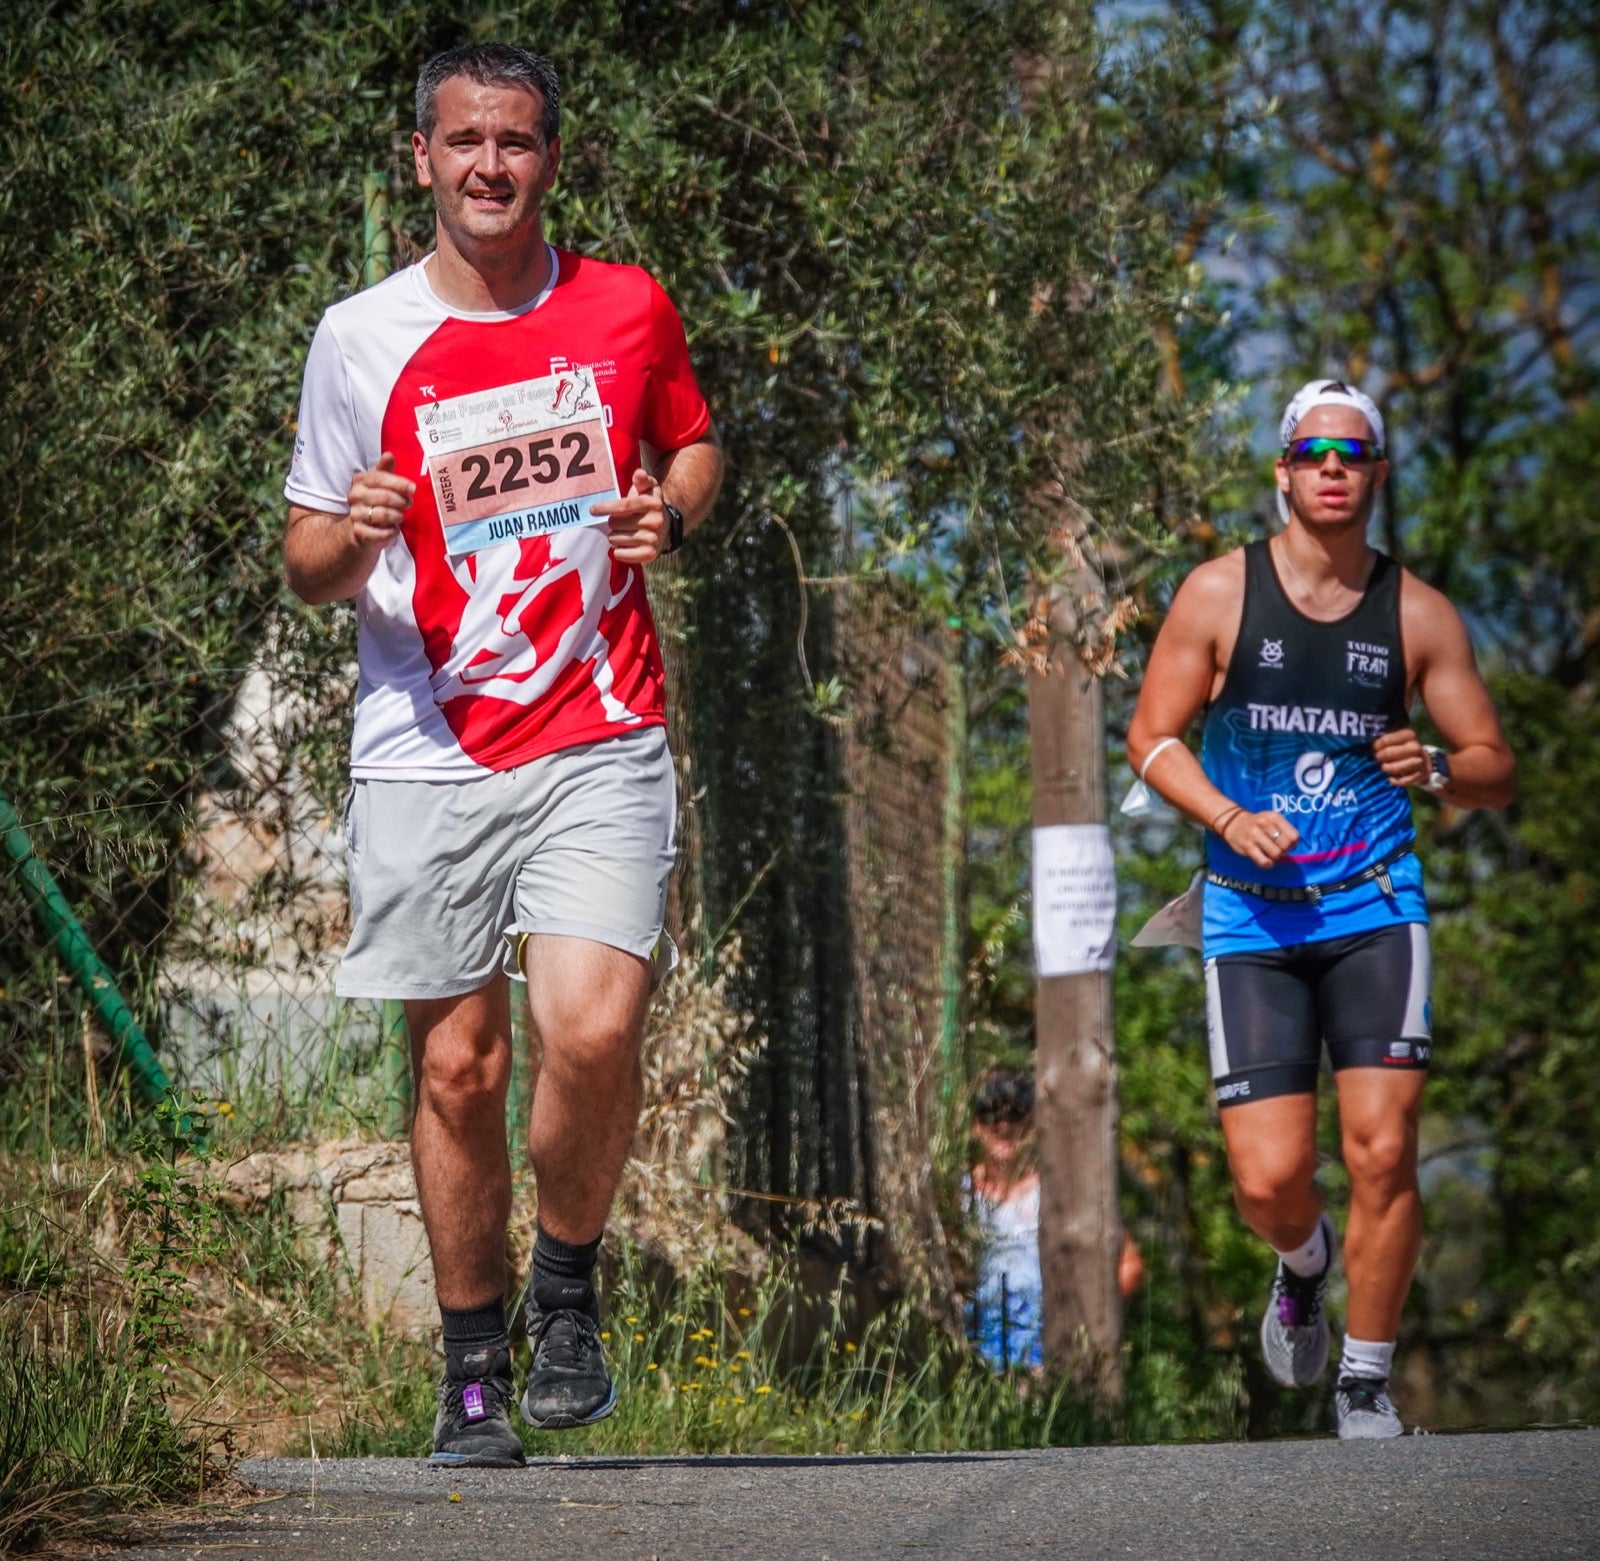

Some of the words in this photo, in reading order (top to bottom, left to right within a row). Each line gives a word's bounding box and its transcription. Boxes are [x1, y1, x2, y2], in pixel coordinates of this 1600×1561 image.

[461, 432, 596, 501] 2252
[440, 475, 457, 513] MASTER
[488, 516, 524, 541] JUAN
[527, 503, 581, 533] RAMÓN
[1346, 652, 1389, 678] FRAN
